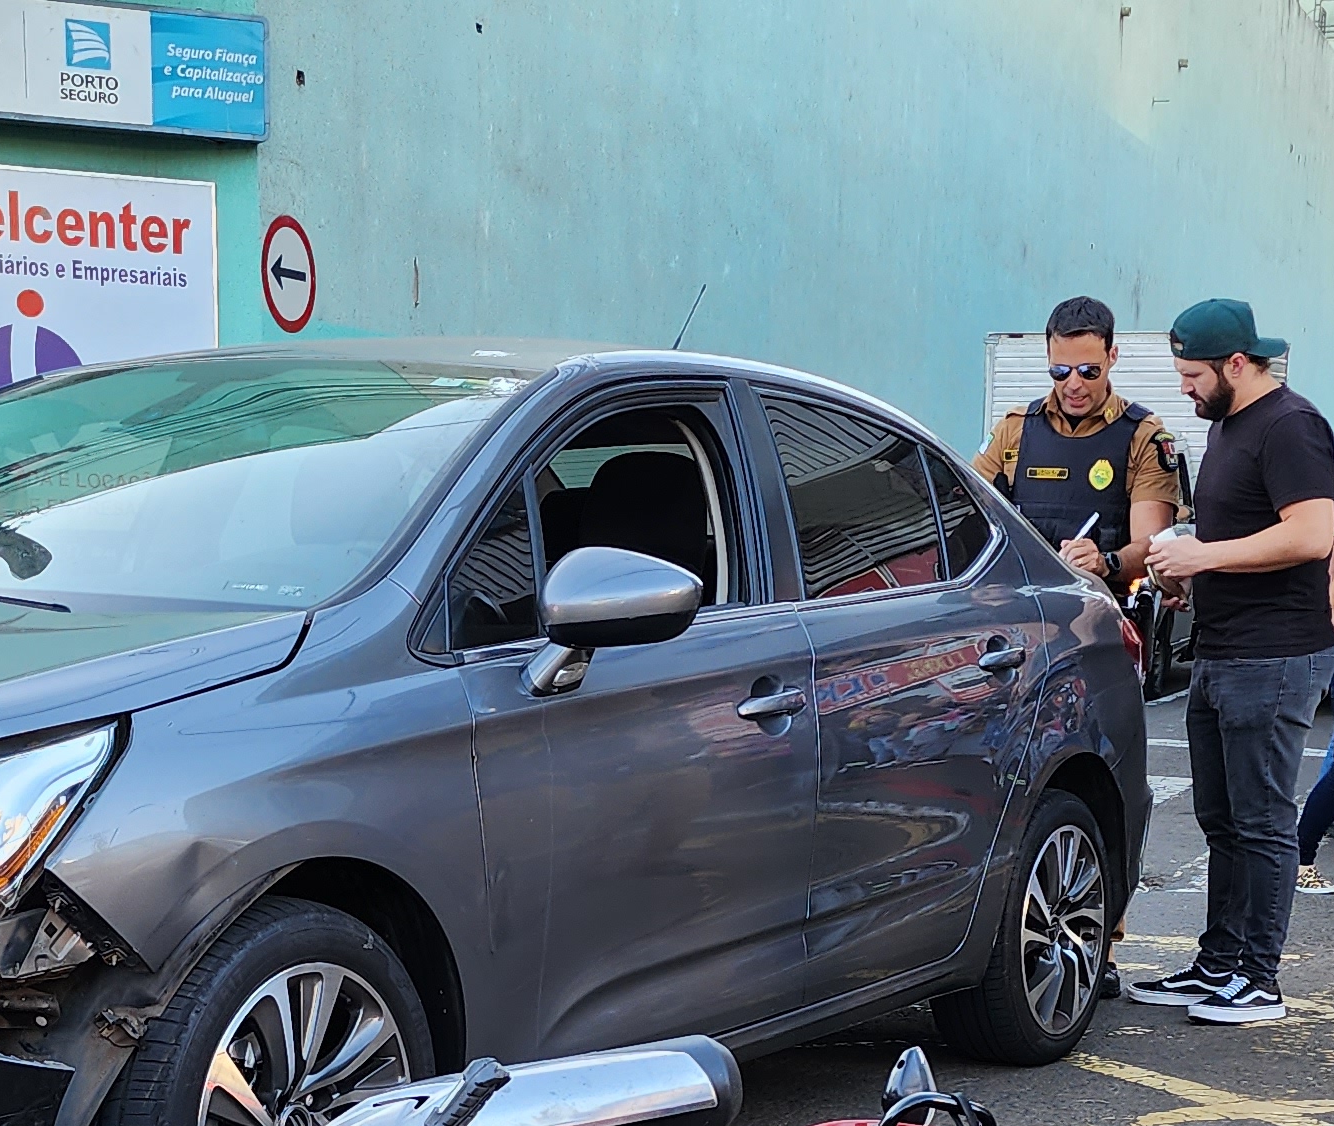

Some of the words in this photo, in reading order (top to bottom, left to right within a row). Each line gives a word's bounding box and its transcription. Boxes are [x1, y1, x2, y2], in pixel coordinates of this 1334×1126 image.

[167, 42, 213, 62] Seguro
[214, 50, 257, 68] Fiança
[60, 72, 118, 91] PORTO
[163, 66, 172, 76] e
[176, 63, 264, 87] Capitalização
[60, 88, 119, 105] SEGURO
[171, 83, 202, 99] para
[204, 85, 254, 104] Aluguel
[55, 263, 66, 279] e
[72, 258, 188, 289] Empresariais
